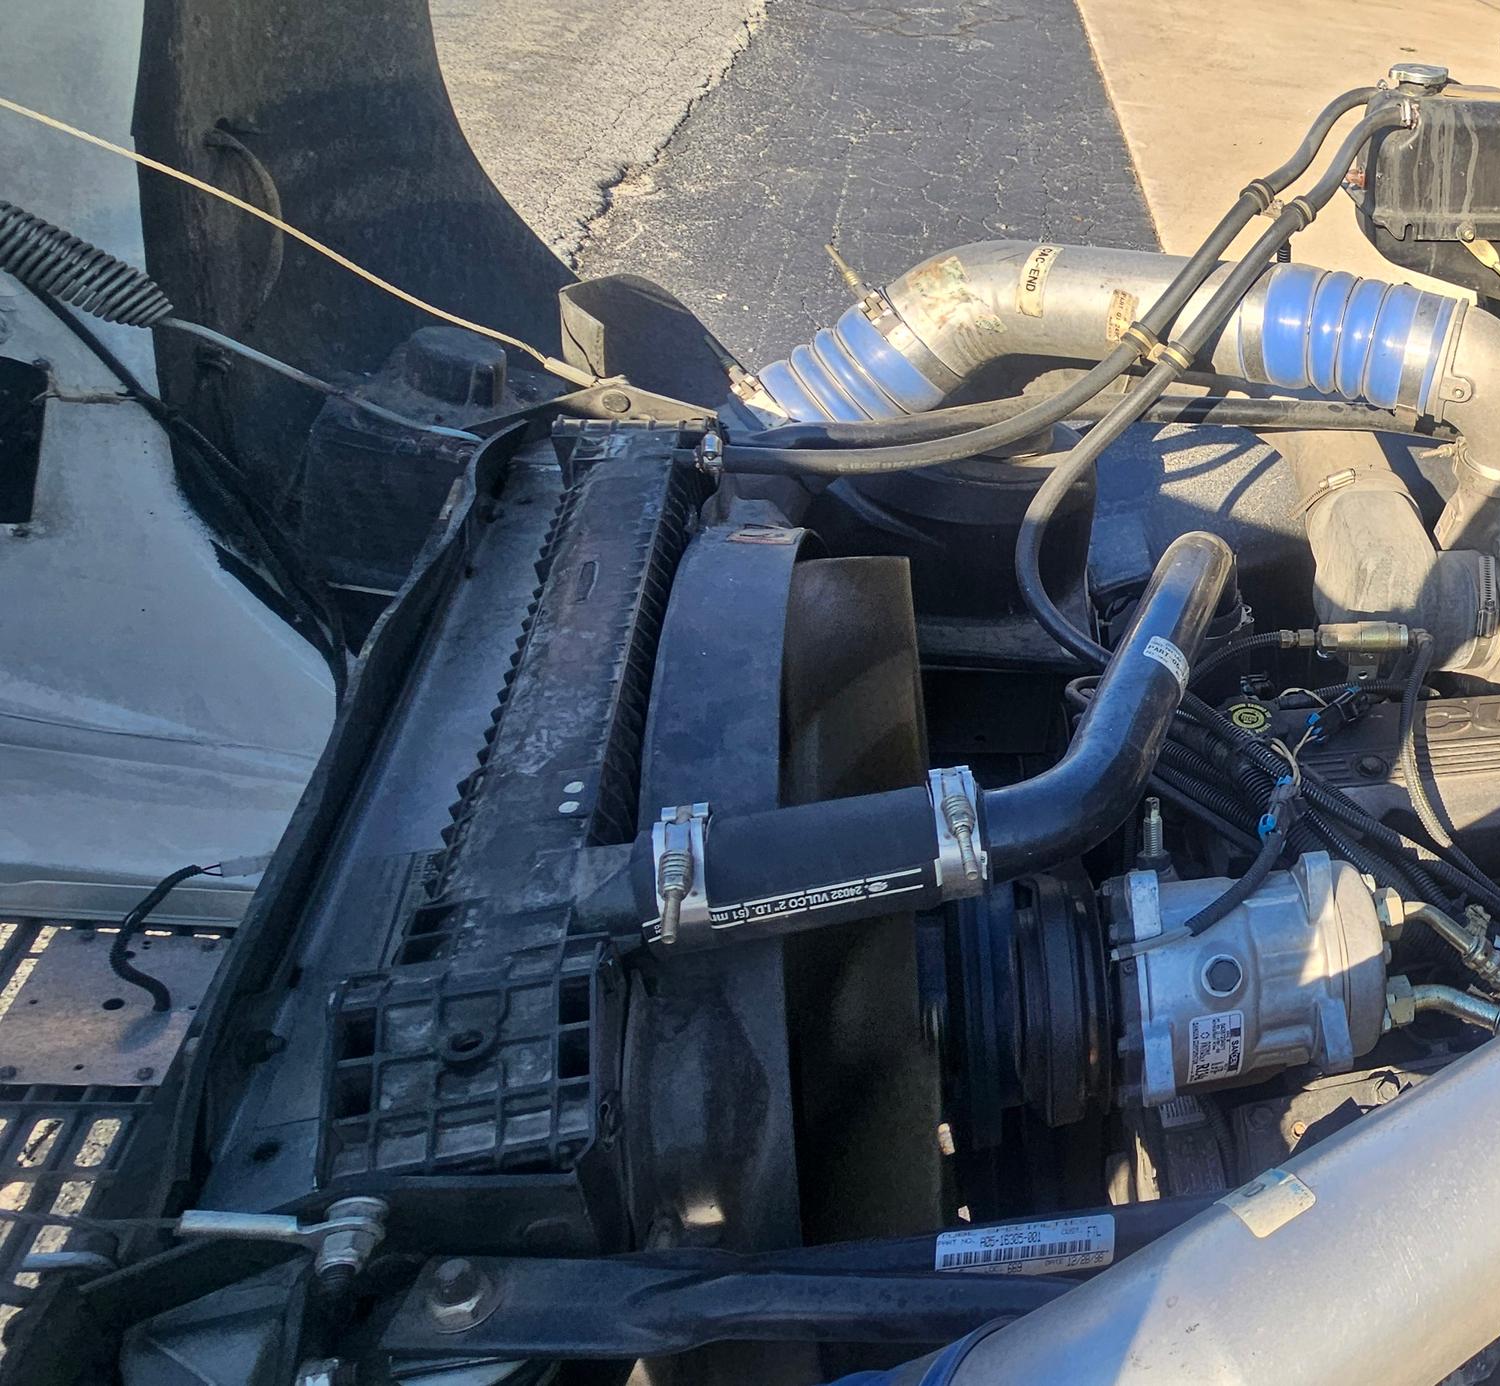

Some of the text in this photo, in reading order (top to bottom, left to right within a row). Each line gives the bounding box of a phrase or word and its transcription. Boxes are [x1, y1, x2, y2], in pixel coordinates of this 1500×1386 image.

[1025, 248, 1053, 292] CAC-END
[831, 885, 863, 900] 24032
[791, 893, 829, 909] VULCO
[732, 905, 750, 920] (51
[752, 903, 772, 916] I.D.
